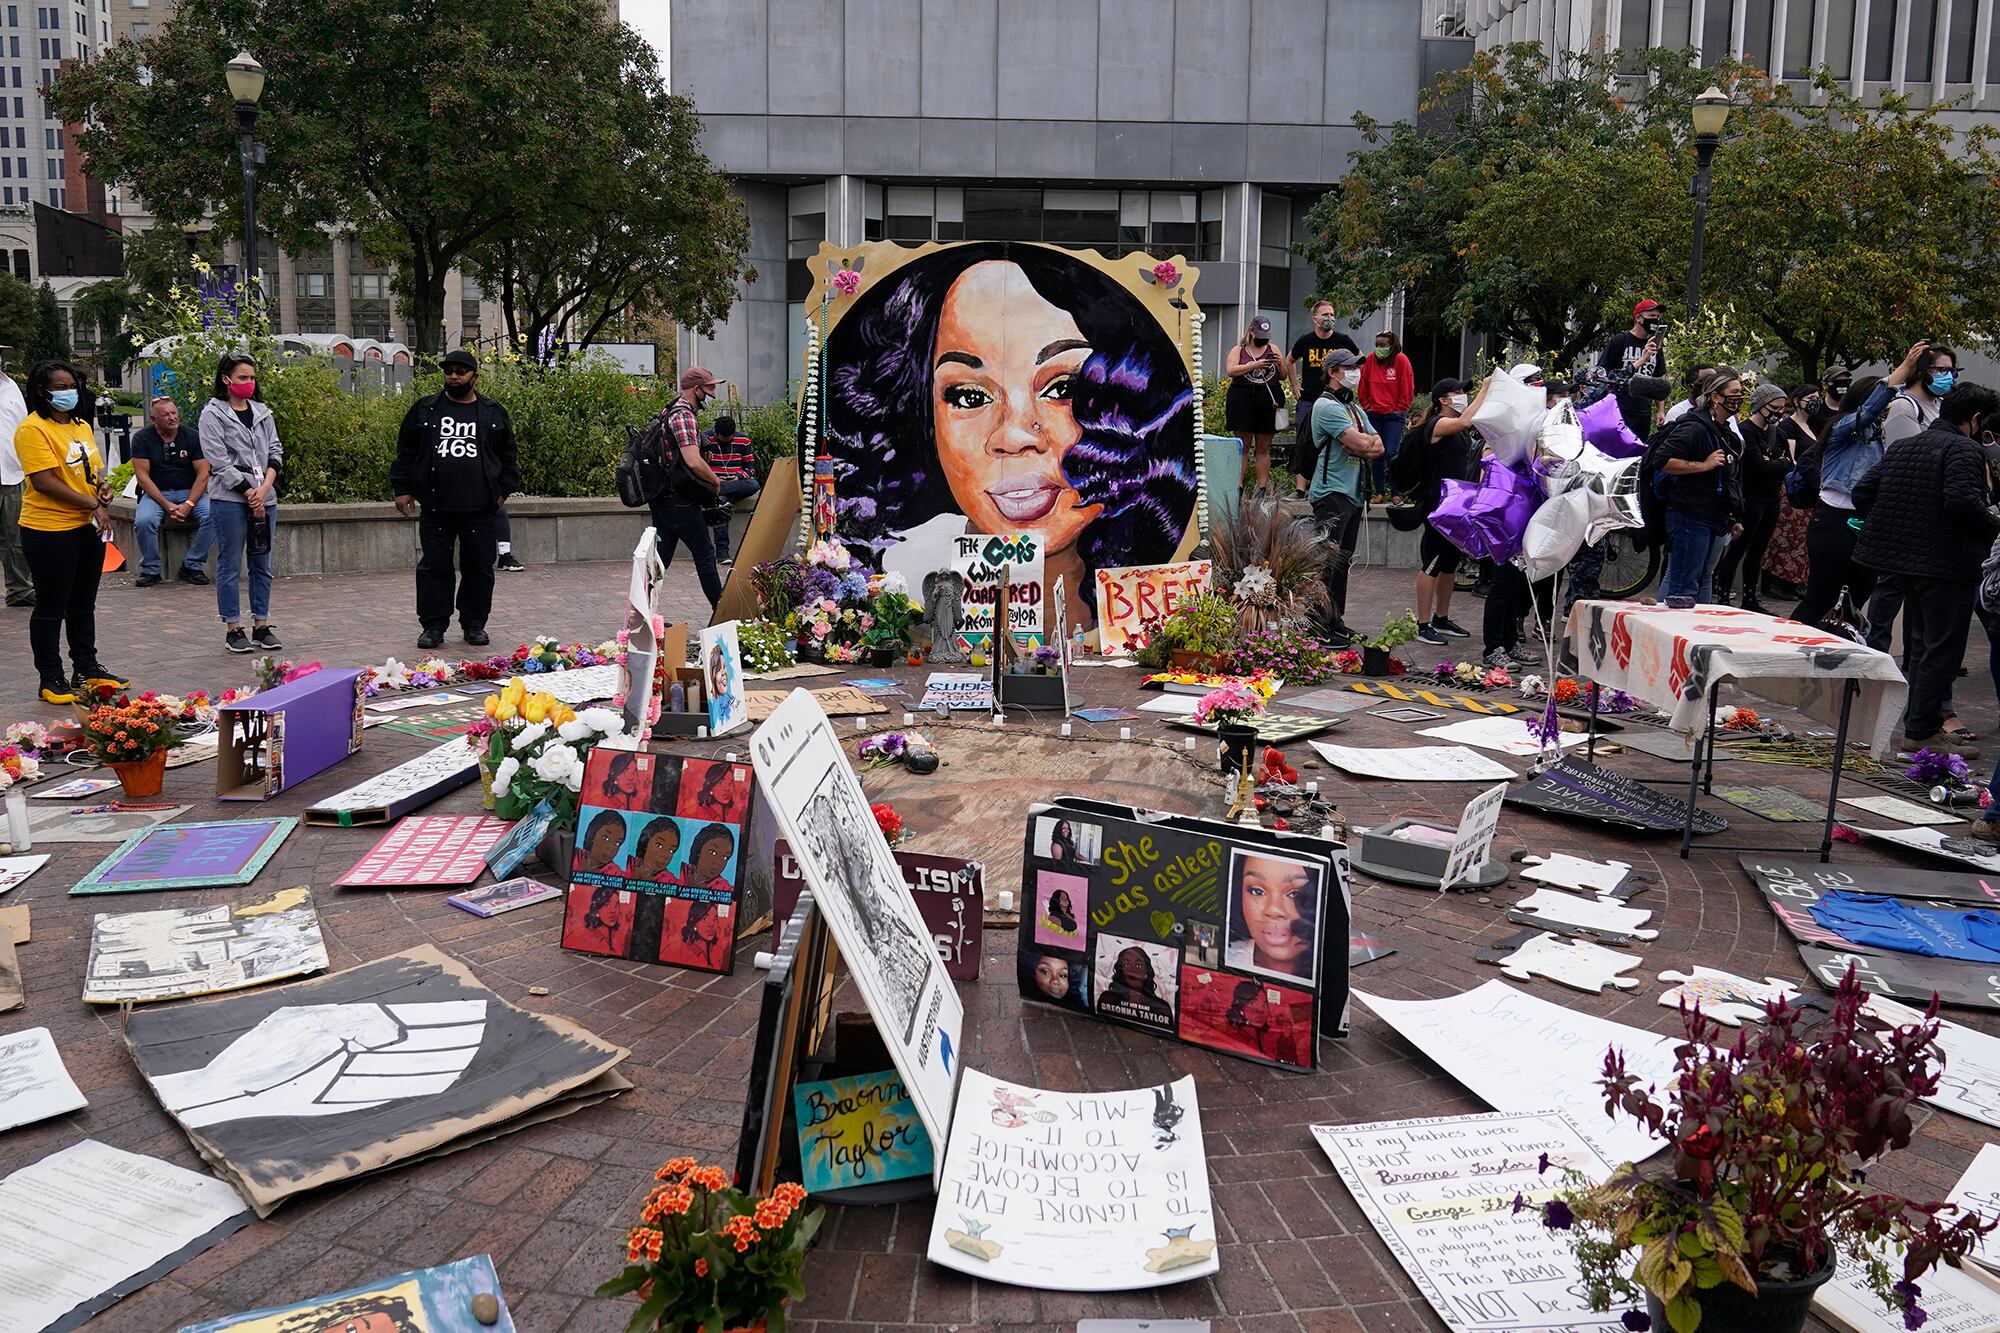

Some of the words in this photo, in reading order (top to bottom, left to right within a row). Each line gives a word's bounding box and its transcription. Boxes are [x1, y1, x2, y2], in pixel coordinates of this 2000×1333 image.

[440, 416, 477, 437] 8m
[437, 439, 478, 458] 46s
[954, 537, 979, 557] THE
[963, 578, 1041, 606] URDRED
[928, 683, 992, 691] RIGHTS
[1104, 836, 1160, 885] She
[782, 854, 975, 895] CLISM
[1092, 886, 1150, 926] was
[1153, 842, 1222, 893] asleep
[1101, 1003, 1137, 1017] BREONNA
[1139, 1011, 1170, 1025] TAYLOR
[1470, 994, 1534, 1035] Say
[1537, 1018, 1595, 1051] her
[1595, 1046, 1673, 1080] nme
[815, 1121, 917, 1179] Taylor
[1085, 1128, 1124, 1147] TO
[1343, 1137, 1365, 1148] If
[1376, 1136, 1408, 1151] my
[1406, 1130, 1466, 1144] babies
[1476, 1125, 1519, 1137] were
[970, 1132, 1140, 1172] ACCOMPLICE
[1357, 1150, 1412, 1168] SHOT
[1427, 1153, 1447, 1163] in
[1450, 1147, 1493, 1160] their
[1500, 1138, 1565, 1154] homes
[969, 1160, 1080, 1198] BECOME
[1166, 1171, 1188, 1193] IS
[1375, 1169, 1459, 1185] Breonna
[1469, 1158, 1534, 1175] Taylor
[951, 1179, 1007, 1215] EVIL
[1108, 1178, 1148, 1199] TO
[1382, 1191, 1421, 1206] OR
[1037, 1198, 1138, 1224] IGNORE
[1407, 1206, 1472, 1221] George
[1482, 1195, 1532, 1211] Flod
[1448, 1222, 1494, 1240] going
[1438, 1238, 1490, 1256] playing
[1494, 1237, 1507, 1246] in
[1513, 1233, 1541, 1243] the
[1464, 1252, 1516, 1269] going
[1518, 1249, 1545, 1260] for
[1553, 1249, 1565, 1257] a
[1439, 1271, 1493, 1286] This
[1503, 1264, 1564, 1282] MAMA
[1452, 1289, 1518, 1323] NOT
[1522, 1291, 1570, 1314] be
